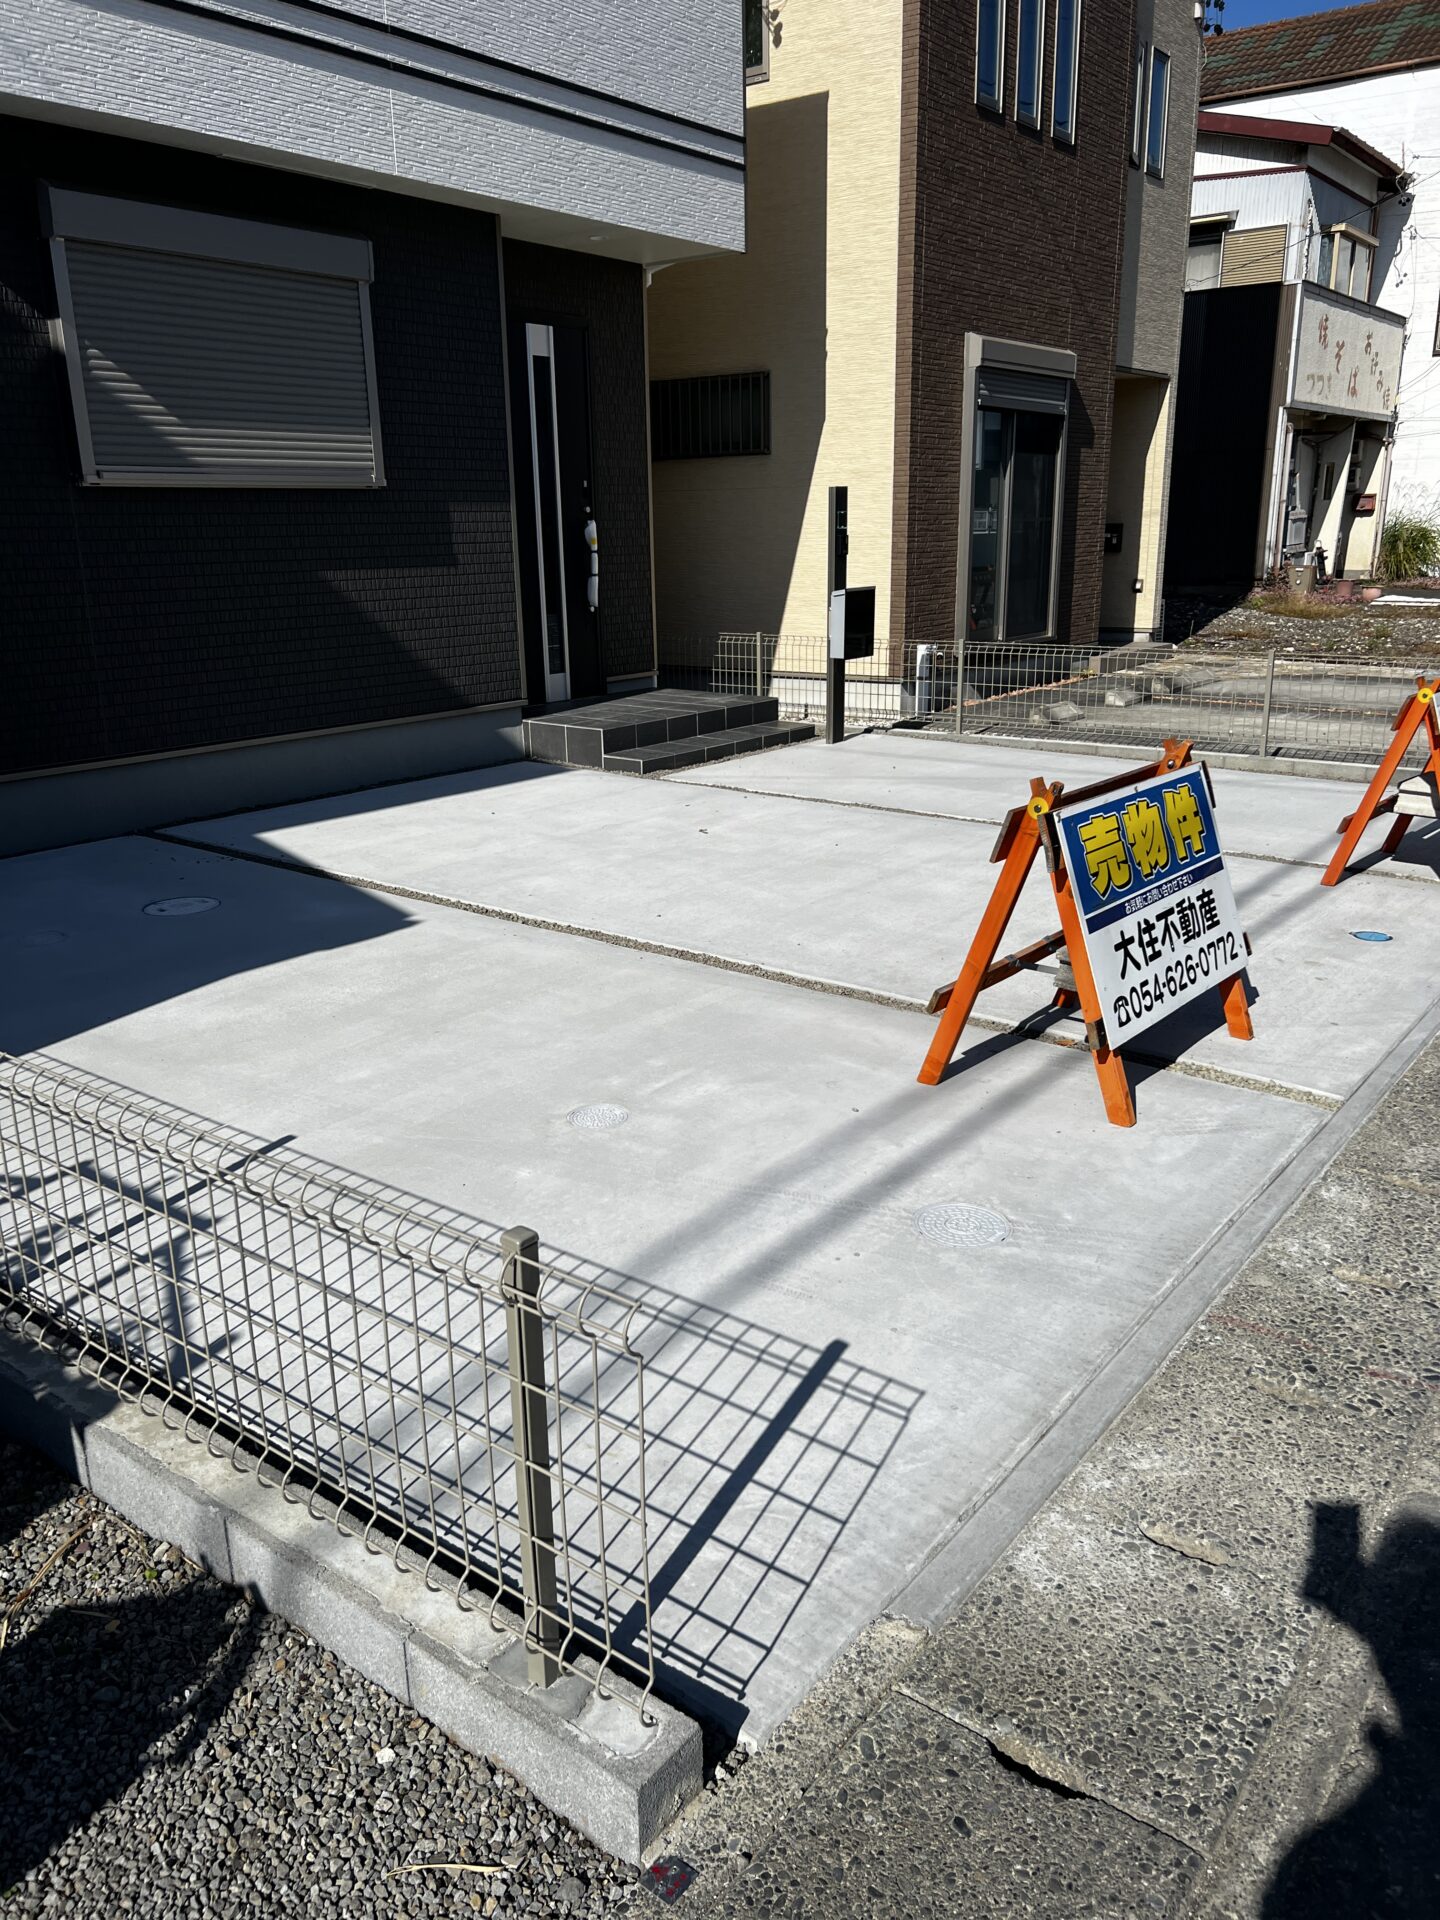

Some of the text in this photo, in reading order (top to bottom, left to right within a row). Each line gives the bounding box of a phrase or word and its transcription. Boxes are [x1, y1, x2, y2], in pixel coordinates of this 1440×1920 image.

[1077, 784, 1205, 897] 売物件
[1114, 888, 1221, 980] 大住不動産
[1125, 873, 1194, 914] お気軽にお問い合わせ下さい
